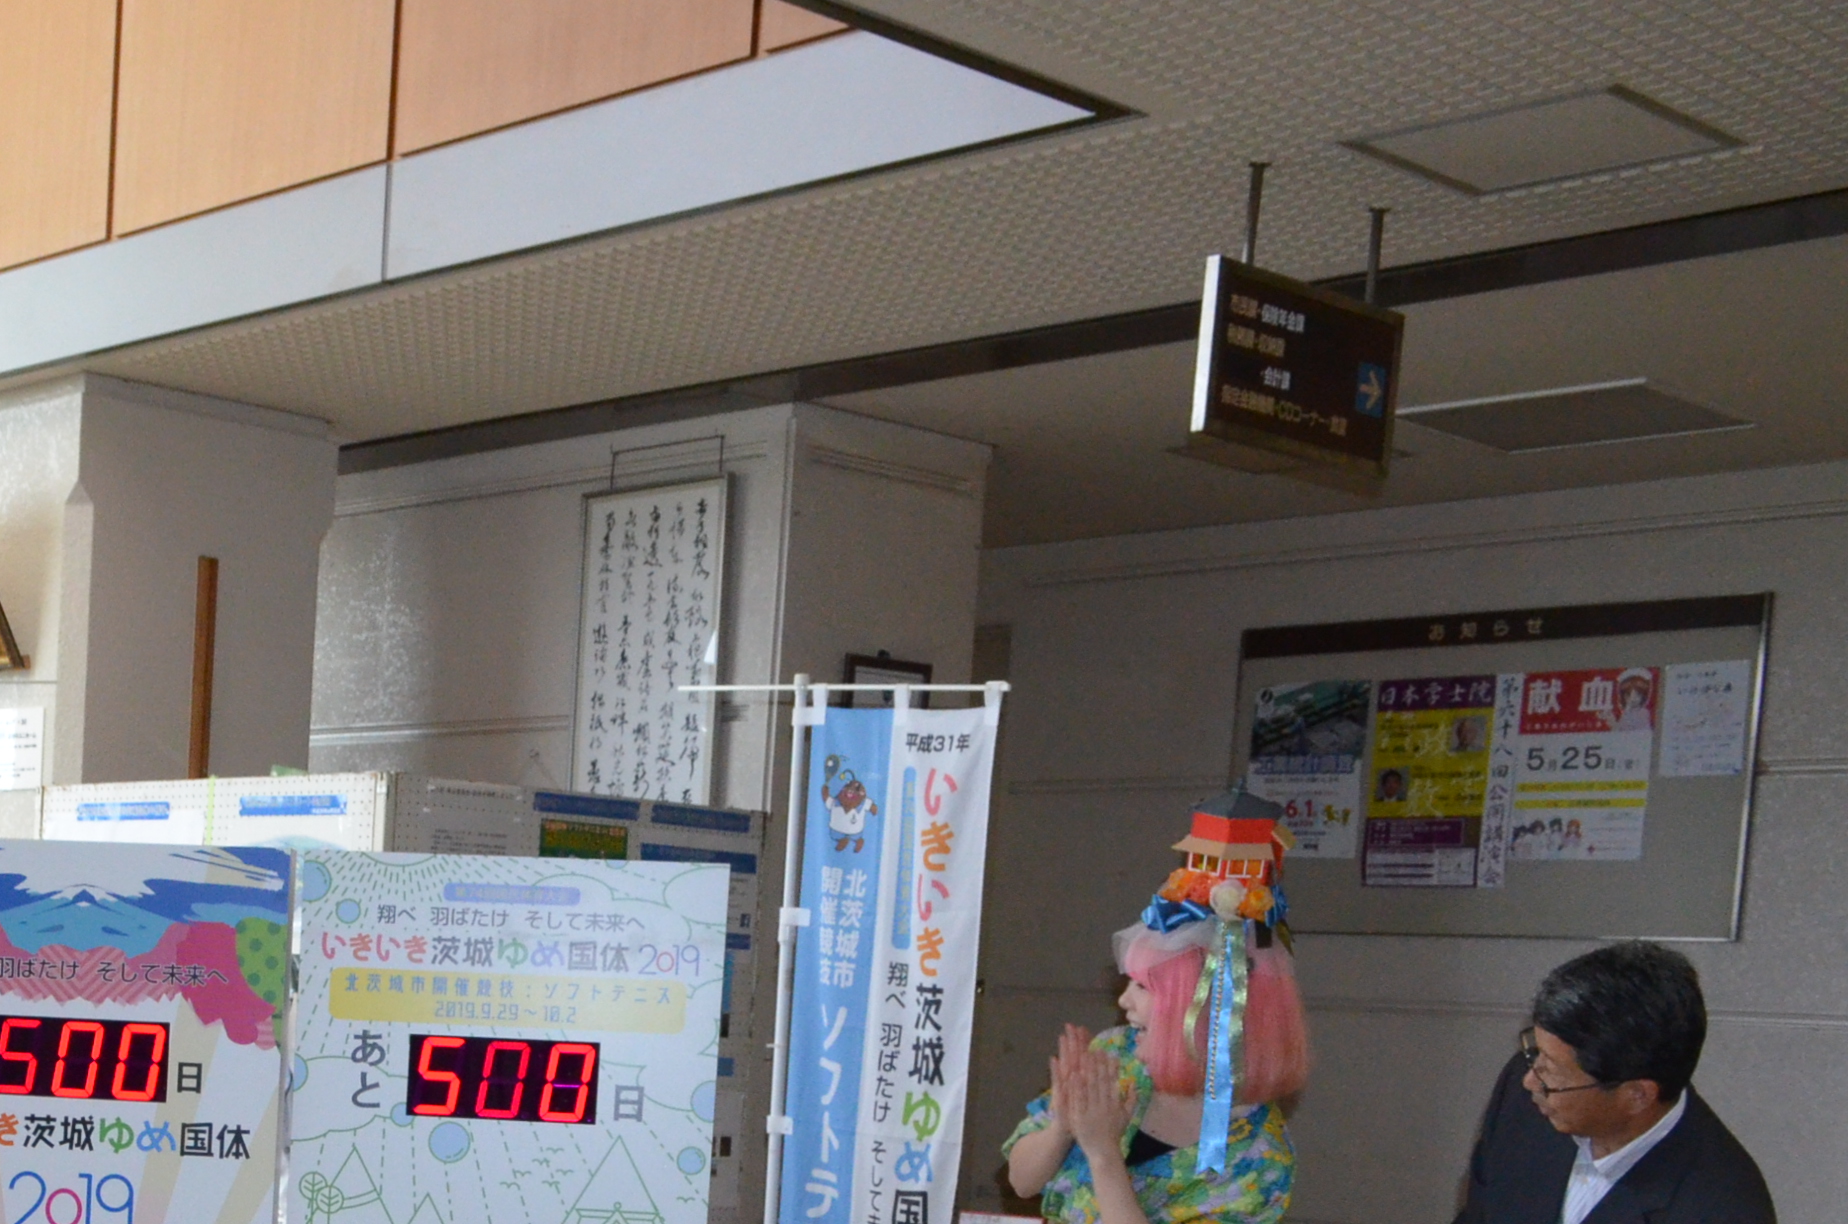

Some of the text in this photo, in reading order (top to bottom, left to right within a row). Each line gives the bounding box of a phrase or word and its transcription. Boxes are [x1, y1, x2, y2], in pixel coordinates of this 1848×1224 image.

[1428, 616, 1543, 641] お知らせ
[1527, 677, 1614, 715] 献血
[905, 733, 971, 754] 平成31年
[376, 903, 645, 933] 翔べ 羽ばたけ そして未来へ
[831, 867, 868, 990] 北茨城市
[321, 931, 701, 977] いきいき茨城ゆめ国体 2019
[97, 961, 228, 987] そして未来へ
[885, 961, 910, 1010] 翔べ
[176, 1062, 202, 1094] 日
[351, 1029, 386, 1110] あと
[413, 1035, 596, 1123] 500
[873, 1022, 903, 1122] 羽ばたけ
[613, 1084, 645, 1122] 日
